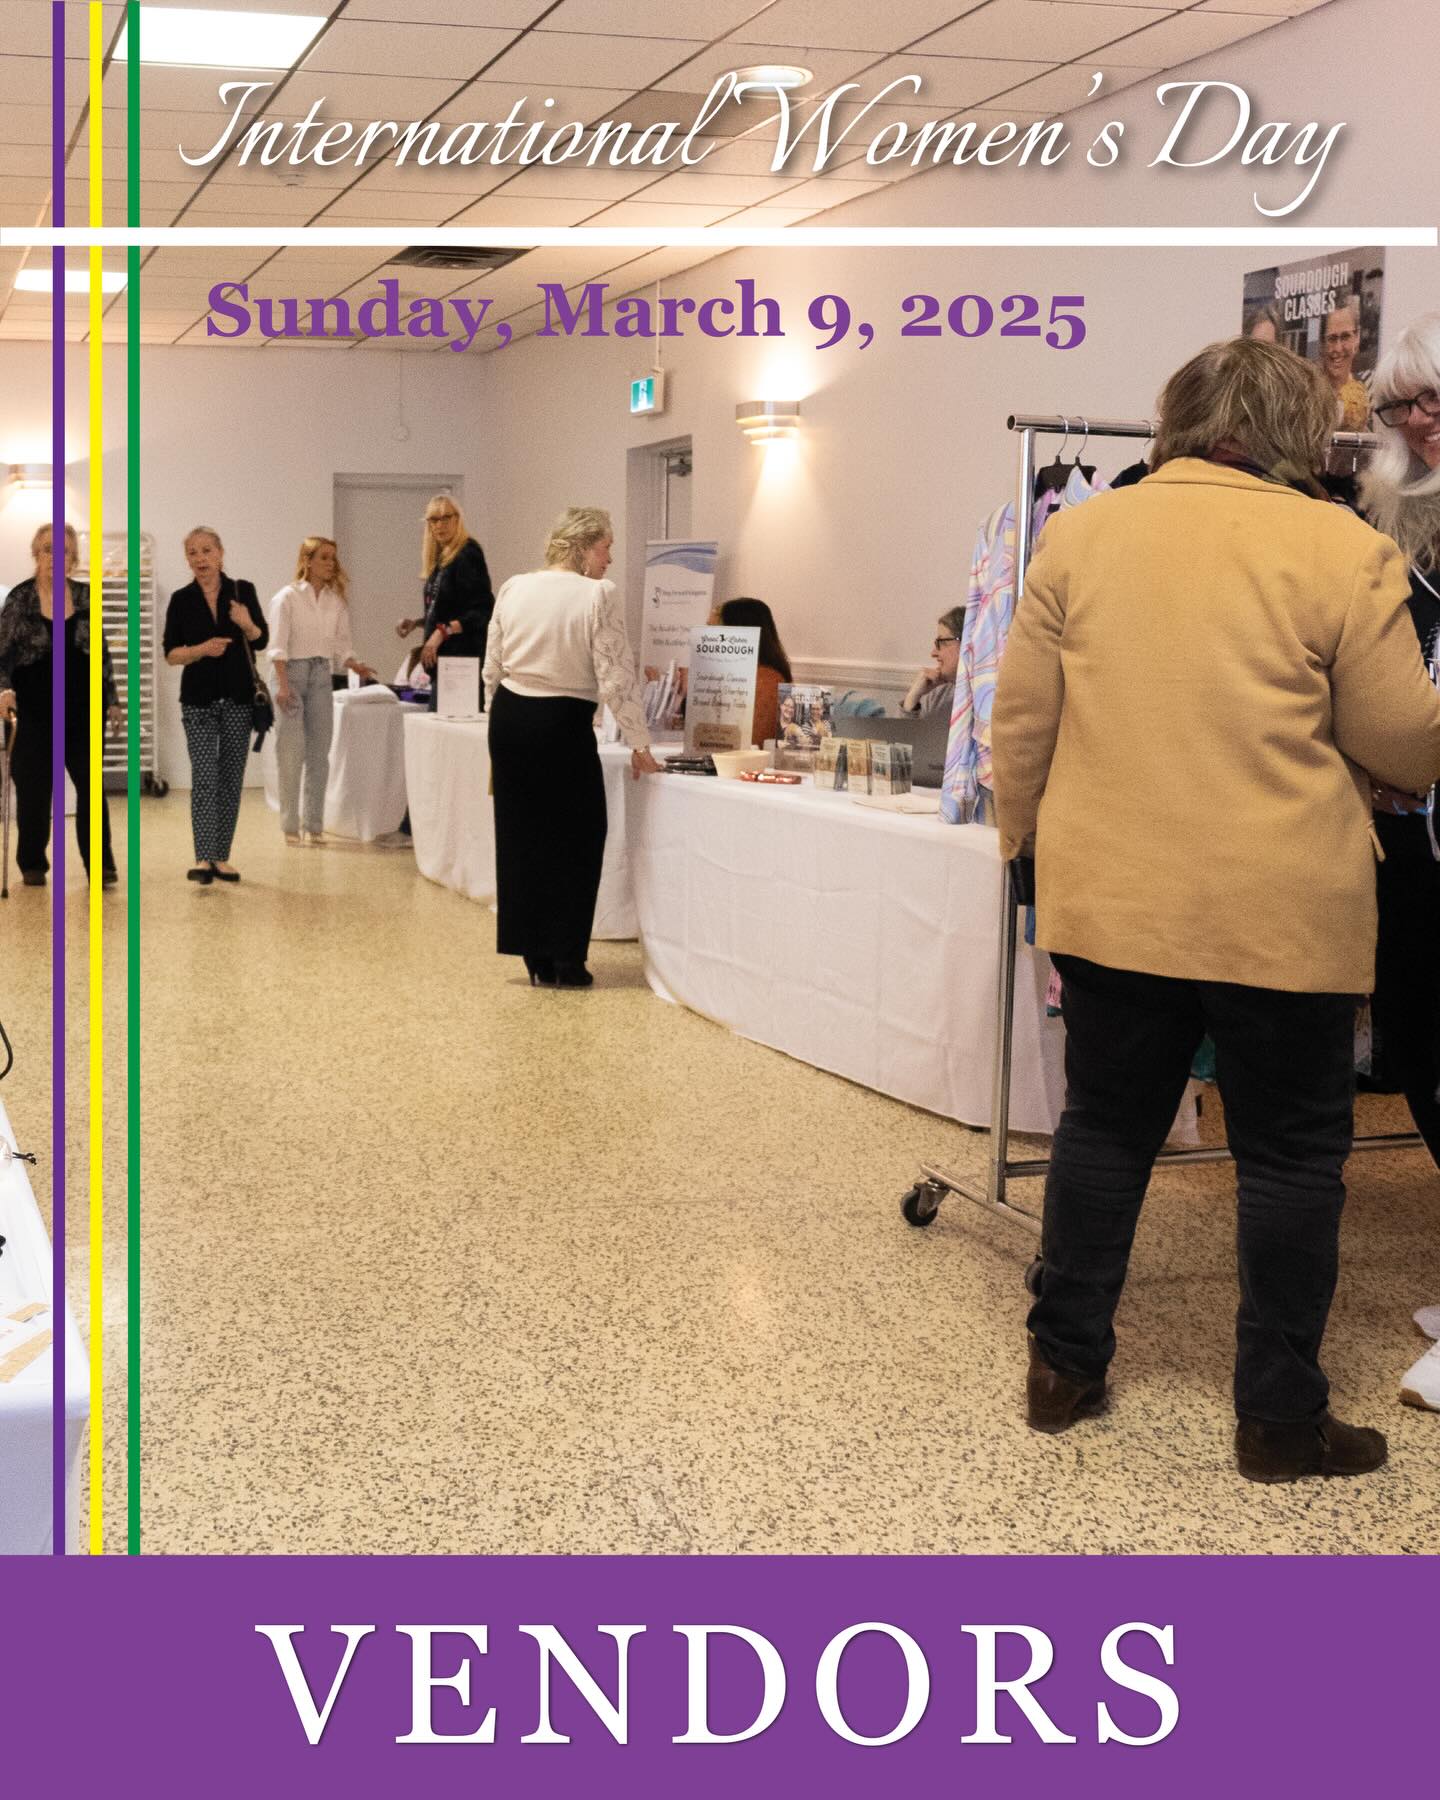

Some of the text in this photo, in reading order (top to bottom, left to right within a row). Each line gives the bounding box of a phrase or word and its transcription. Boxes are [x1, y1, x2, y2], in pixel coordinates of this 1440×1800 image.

[1274, 262, 1349, 300] SOURDOUGH
[1284, 290, 1337, 322] CLASSES
[696, 644, 754, 655] SOURDOUGH
